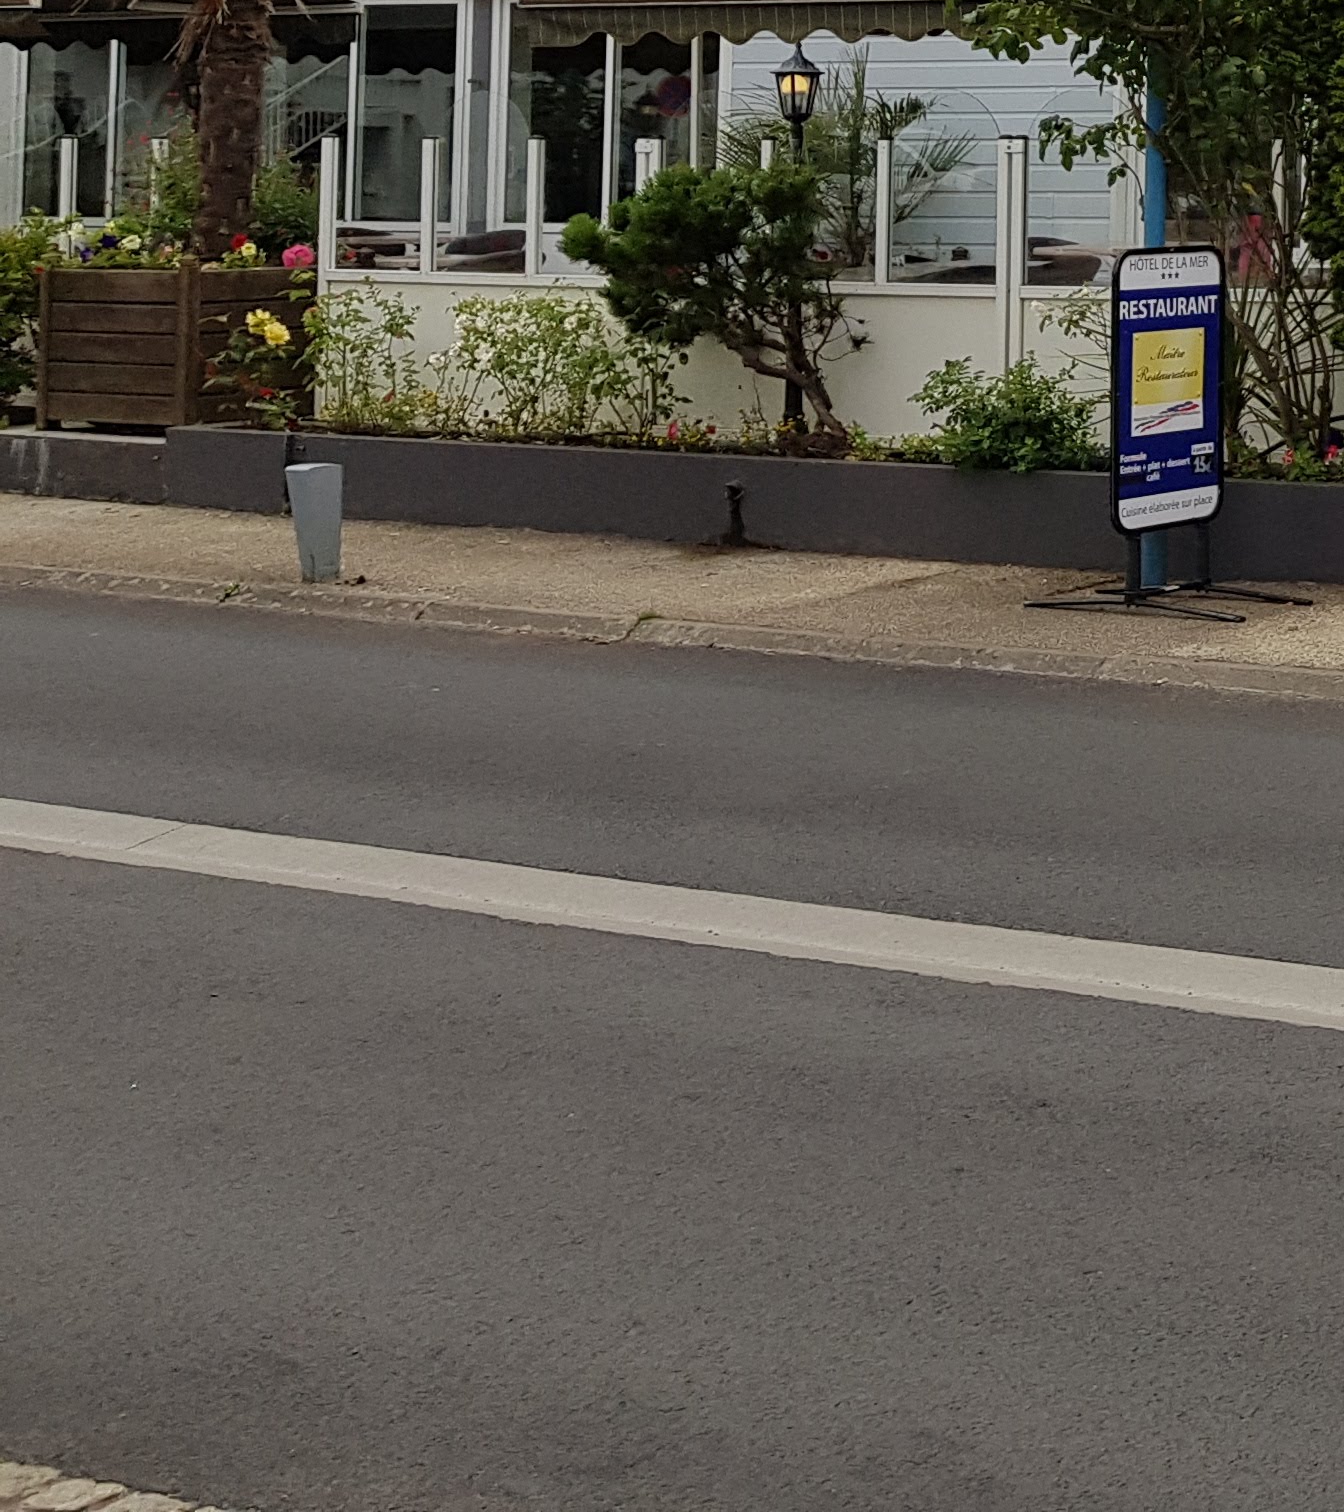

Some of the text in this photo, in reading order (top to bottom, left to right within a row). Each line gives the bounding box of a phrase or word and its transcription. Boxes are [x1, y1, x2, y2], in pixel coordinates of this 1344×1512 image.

[1129, 256, 1208, 271] HÔTEL DE LA MER
[1119, 295, 1218, 320] RESTAURANT
[1122, 507, 1147, 517] Cuisine
[1182, 499, 1191, 508] sur
[1194, 495, 1212, 507] place
